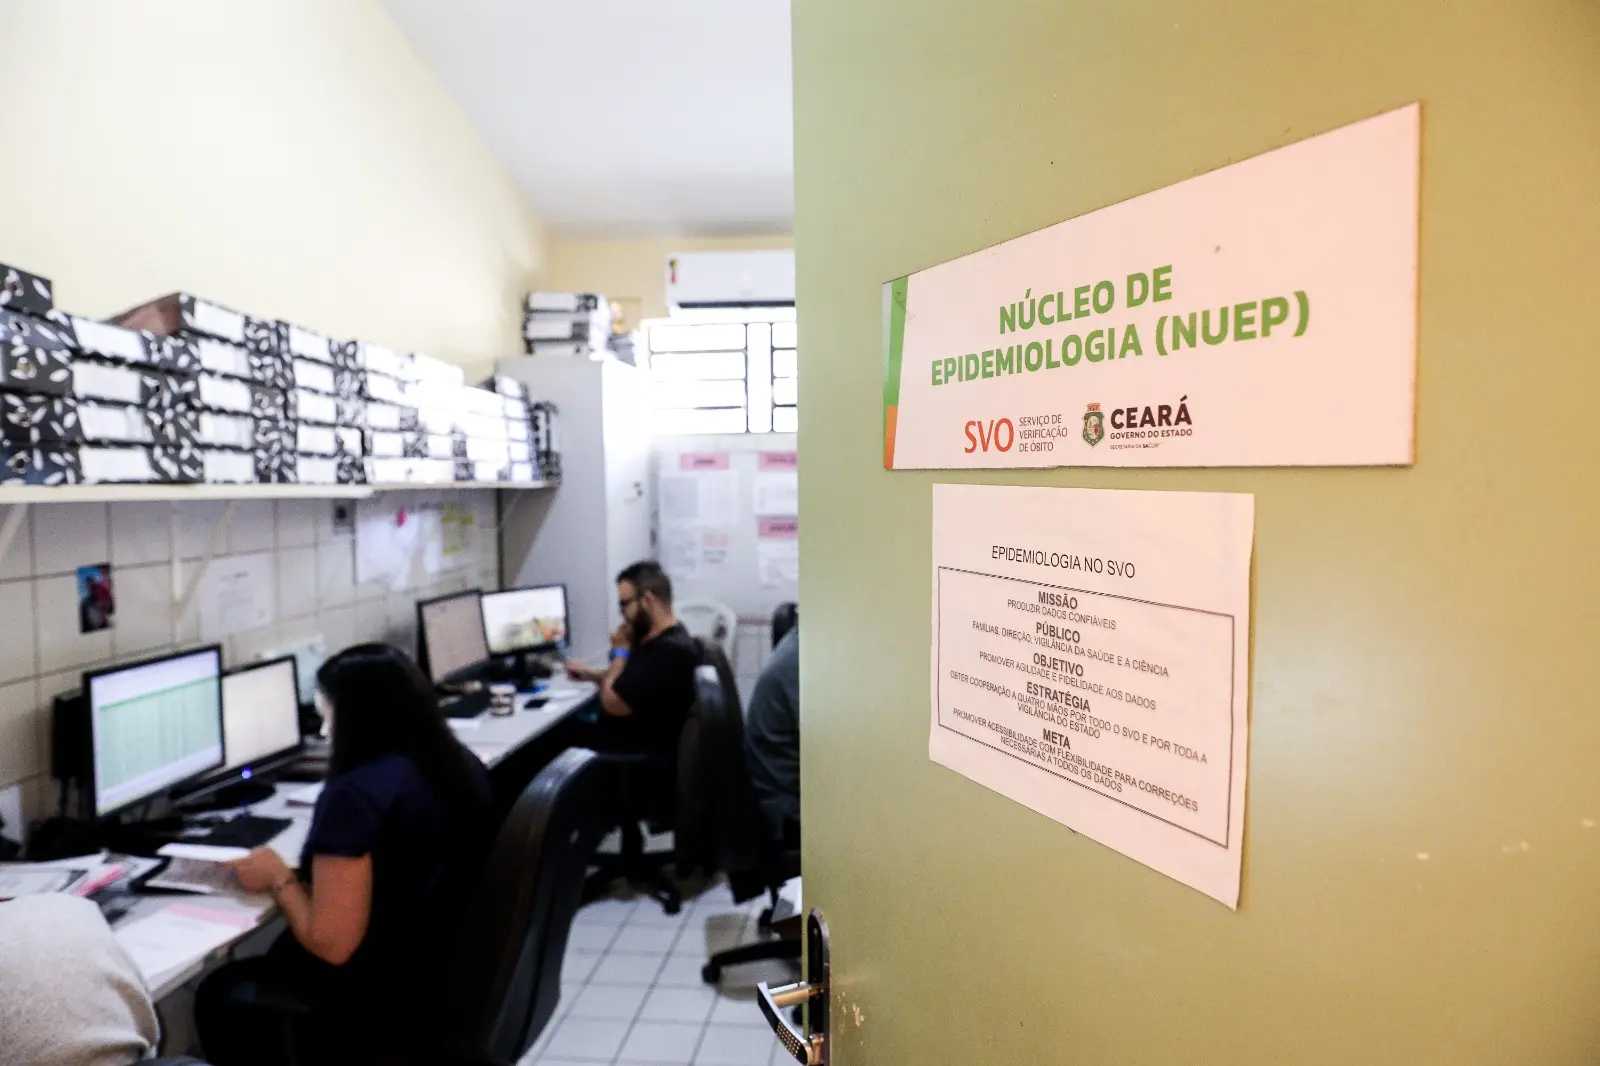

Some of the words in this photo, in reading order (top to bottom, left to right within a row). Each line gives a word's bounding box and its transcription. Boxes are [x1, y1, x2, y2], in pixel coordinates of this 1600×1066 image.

[1000, 280, 1115, 334] NÚCLEO
[1126, 264, 1172, 308] DE
[932, 324, 1143, 386] EPIDEMIOLOGIA
[1156, 290, 1310, 356] (NUEP)
[1019, 415, 1050, 427] SERVIÇO
[1052, 414, 1062, 424] DE
[1110, 394, 1192, 429] CEARÁ
[964, 418, 1014, 453] SVO
[1019, 426, 1068, 440] VERIFICAÇÃO
[1019, 442, 1028, 452] DE
[1030, 440, 1054, 451] ÓBITO
[1110, 431, 1146, 440] GOVERNO
[1161, 428, 1192, 438] ESTADO
[992, 546, 1081, 571] EPIDEMIOLOGIA
[1084, 556, 1103, 574] NO
[1107, 559, 1135, 578] SVO
[1008, 599, 1040, 614] PRODUZIR
[1042, 606, 1066, 619] DADOS
[1069, 612, 1116, 630] CONFIÁVEIS
[1038, 591, 1078, 609] MISSÃO
[1036, 621, 1080, 643] PÚBLICO
[1034, 652, 1084, 676] OBJETIVO
[1075, 645, 1085, 656] DA
[1087, 648, 1114, 663] SAÚDE
[1117, 656, 1122, 665] E
[1125, 658, 1130, 667] A
[1132, 660, 1169, 677] CIÊNCIA
[980, 650, 1014, 668] PROMOVER
[1016, 662, 1050, 680] AGILIDADE
[1052, 672, 1057, 681] E
[1059, 674, 1104, 695] FIDELIDADE
[1106, 687, 1122, 700] AOS
[1125, 692, 1156, 710] DADOS
[1027, 681, 1090, 712] ESTRATÉGIA
[970, 676, 1010, 698] COOPERAÇÃO
[1012, 691, 1016, 700] A
[1018, 692, 1045, 709] QUATRO
[1047, 702, 1068, 717] MÃOS
[1070, 710, 1086, 723] POR
[1089, 716, 1111, 731] TODO
[1113, 724, 1120, 734] O
[1122, 727, 1140, 741] SVO
[1142, 733, 1148, 744] E
[1150, 736, 1171, 751] POR
[1173, 743, 1198, 761] TODA
[1200, 752, 1208, 764] A
[1057, 716, 1068, 727] DO
[1069, 720, 1100, 738] ESTADO
[1043, 728, 1071, 750] META
[953, 708, 986, 727] PROMOVER
[988, 720, 1037, 748] ACESSIBILIDADE
[1039, 742, 1056, 755] COM
[1058, 748, 1112, 778] FLEXIBILIDADE
[1115, 770, 1137, 787] PARA
[1139, 780, 1198, 812] CORREÇÕES
[1047, 755, 1052, 764] A
[1054, 757, 1079, 775] TODOS
[1081, 768, 1092, 780] OS
[1094, 773, 1122, 793] DADOS
